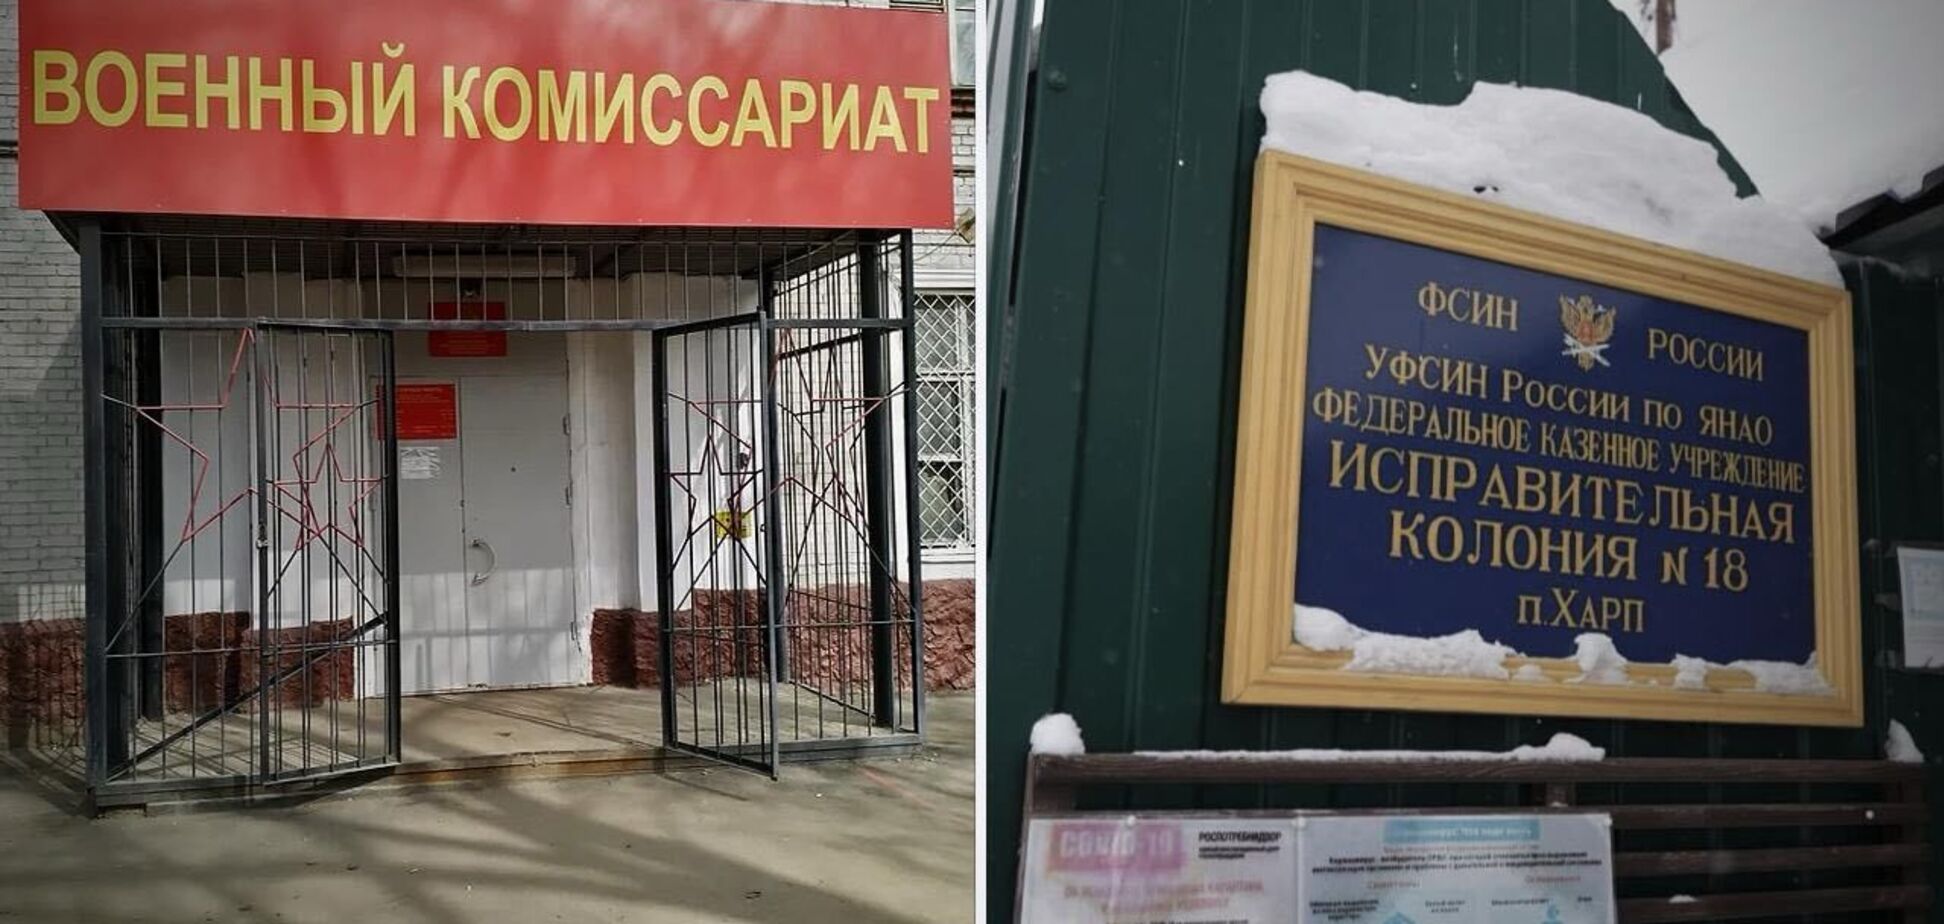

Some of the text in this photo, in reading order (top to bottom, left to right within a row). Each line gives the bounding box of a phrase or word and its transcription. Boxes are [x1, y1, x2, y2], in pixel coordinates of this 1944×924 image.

[33, 42, 940, 153] ВОЕННЫЙ КОМИССАРИАТ
[1418, 282, 1763, 381] ФСИН РОССИИ
[1313, 388, 1805, 493] ФЕДЕРАЛЬНОЕ КАЗЕННОЕ УЧРЕЖДЕНИЕ
[1365, 343, 1488, 398] УФСИН
[1700, 405, 1772, 446] ЯНАО
[1329, 440, 1795, 544] ИСПРАВИТЕЛЬНАЯ
[1389, 510, 1637, 580] КОЛОНИЯ
[1705, 548, 1749, 592] 18
